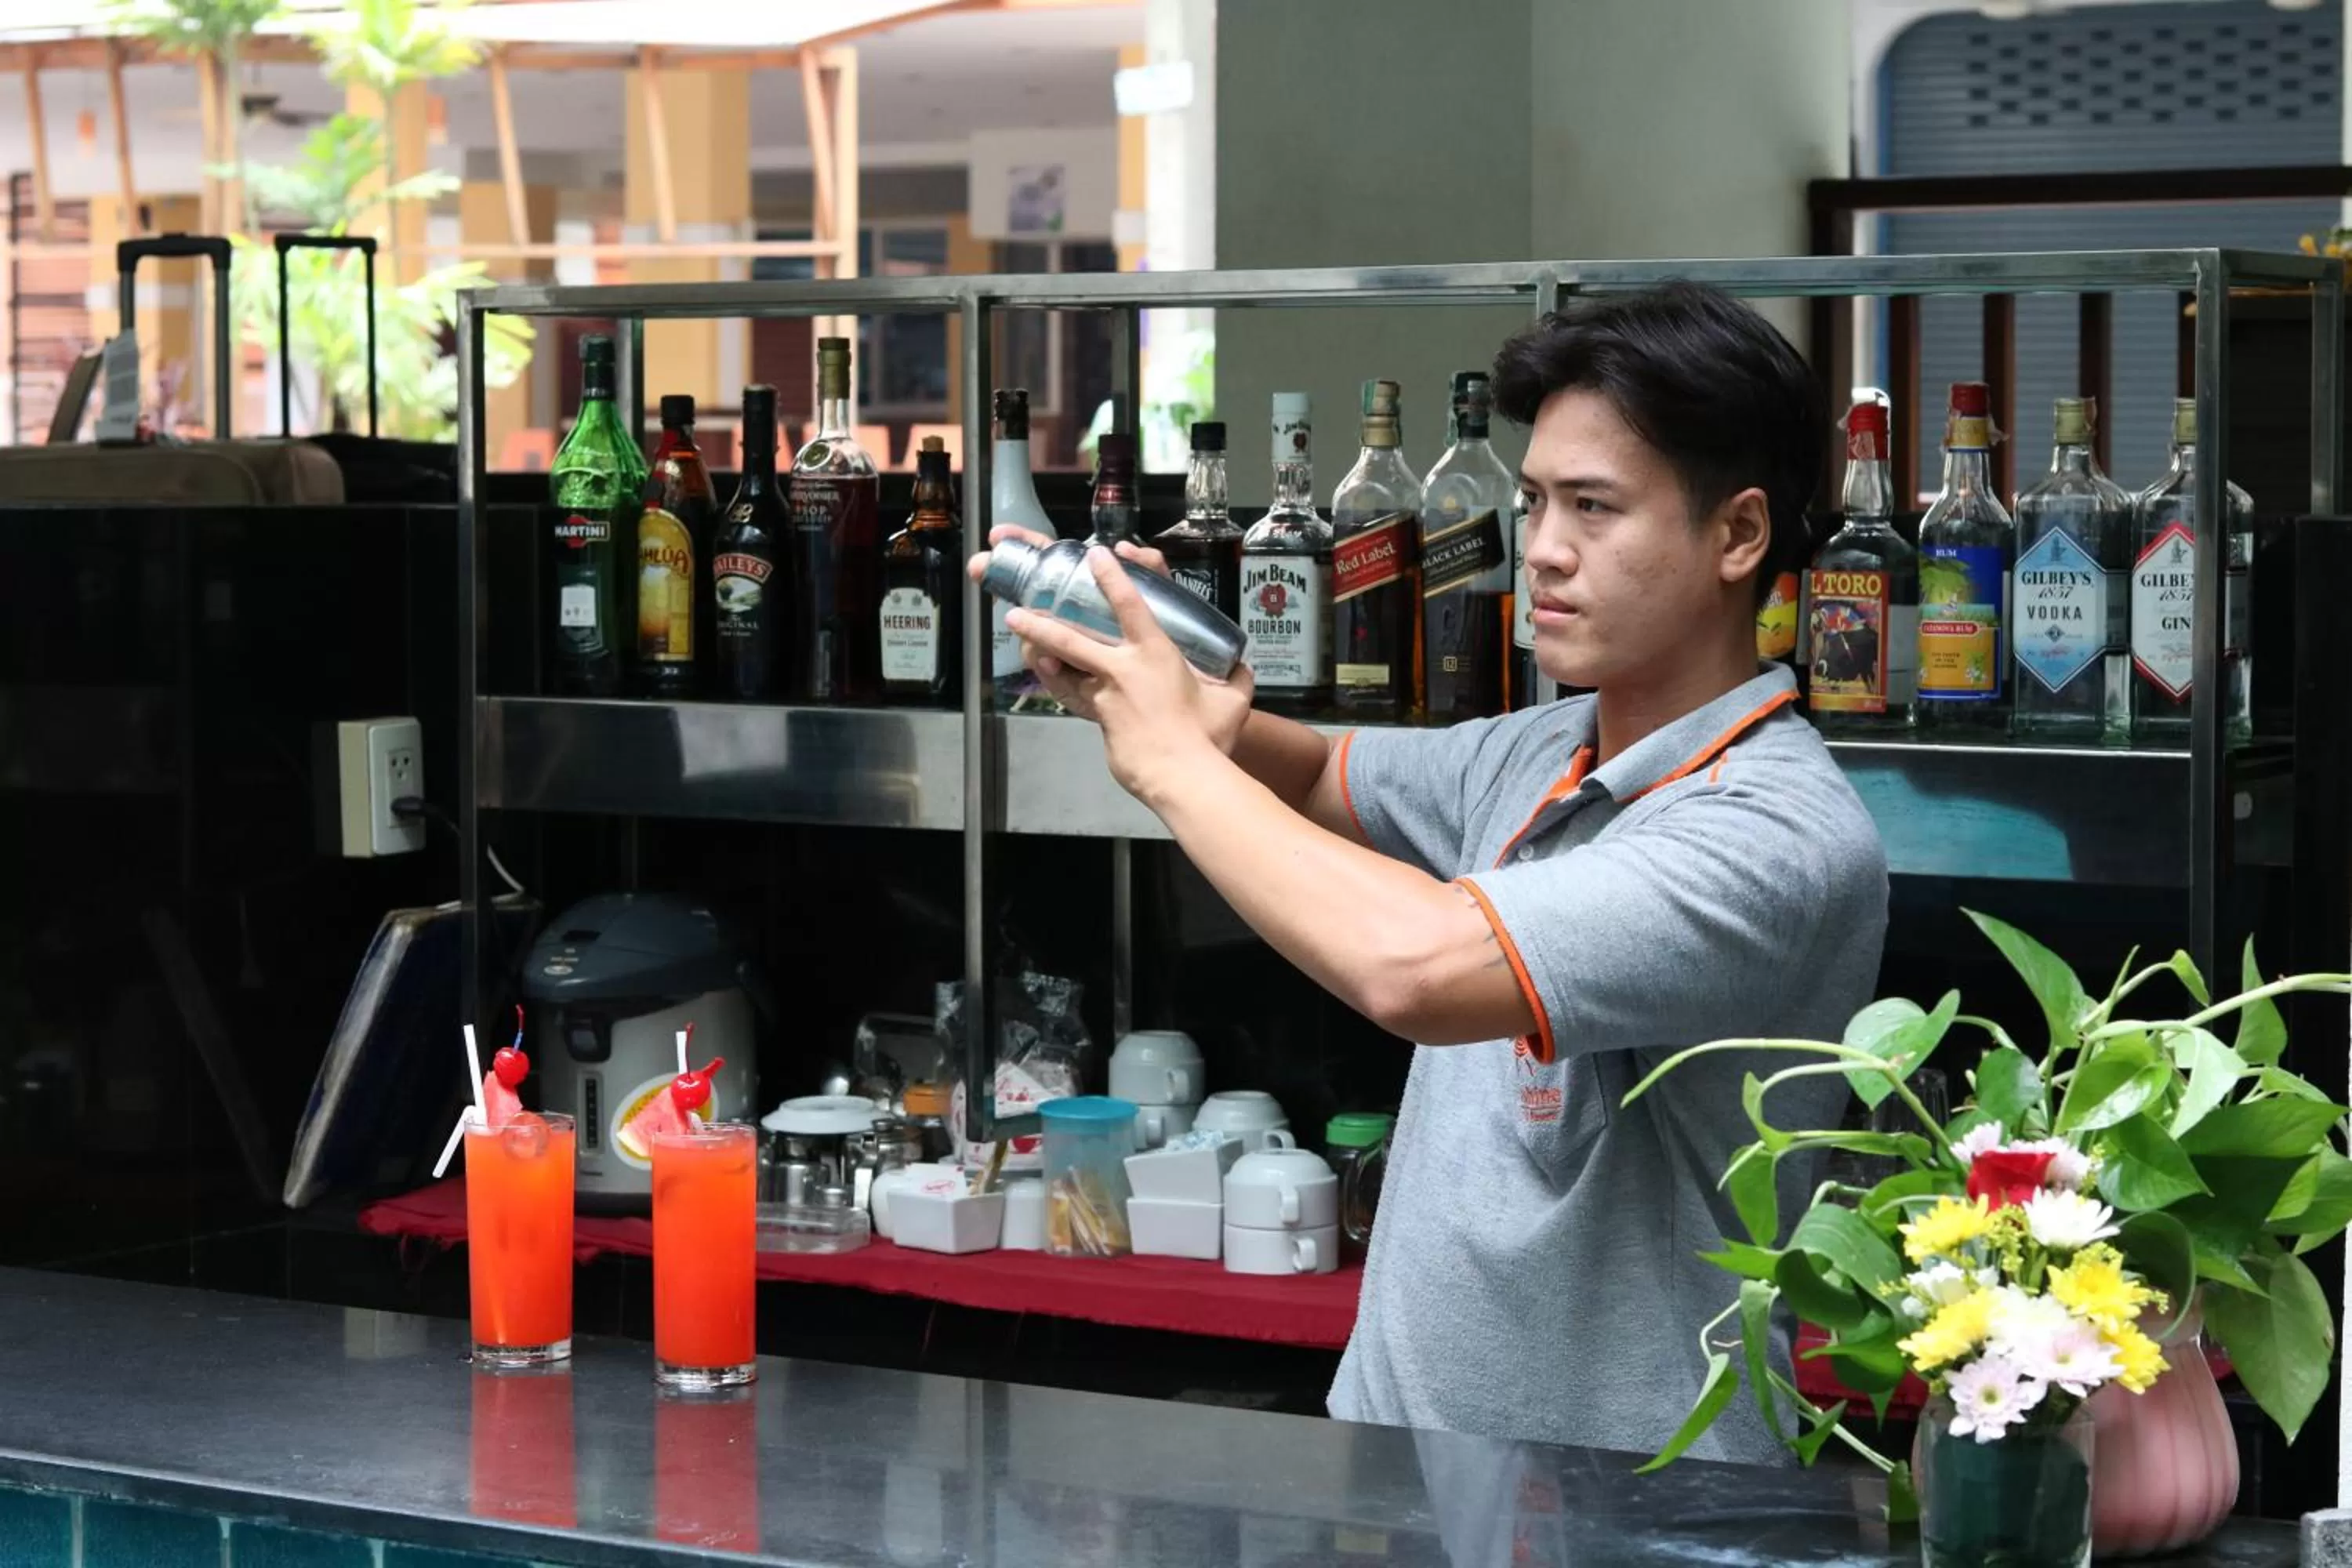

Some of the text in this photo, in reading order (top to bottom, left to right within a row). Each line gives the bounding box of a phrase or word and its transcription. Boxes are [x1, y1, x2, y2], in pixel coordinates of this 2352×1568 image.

[554, 525, 605, 537] MARTINI
[1454, 537, 1486, 556] LABEL
[1336, 557, 1359, 575] Red
[1361, 541, 1396, 564] Label
[1243, 567, 1266, 593] JIM
[1269, 564, 1307, 593] BEAM
[1823, 574, 1882, 595] TORO
[2021, 571, 2092, 586] GILBEY'S
[2140, 573, 2194, 588] GILBE
[2038, 586, 2074, 599] 1857
[2027, 604, 2083, 620] VODKA
[884, 614, 931, 630] HEERING
[1247, 619, 1301, 634] BOURBON
[2161, 616, 2192, 630] GIN
